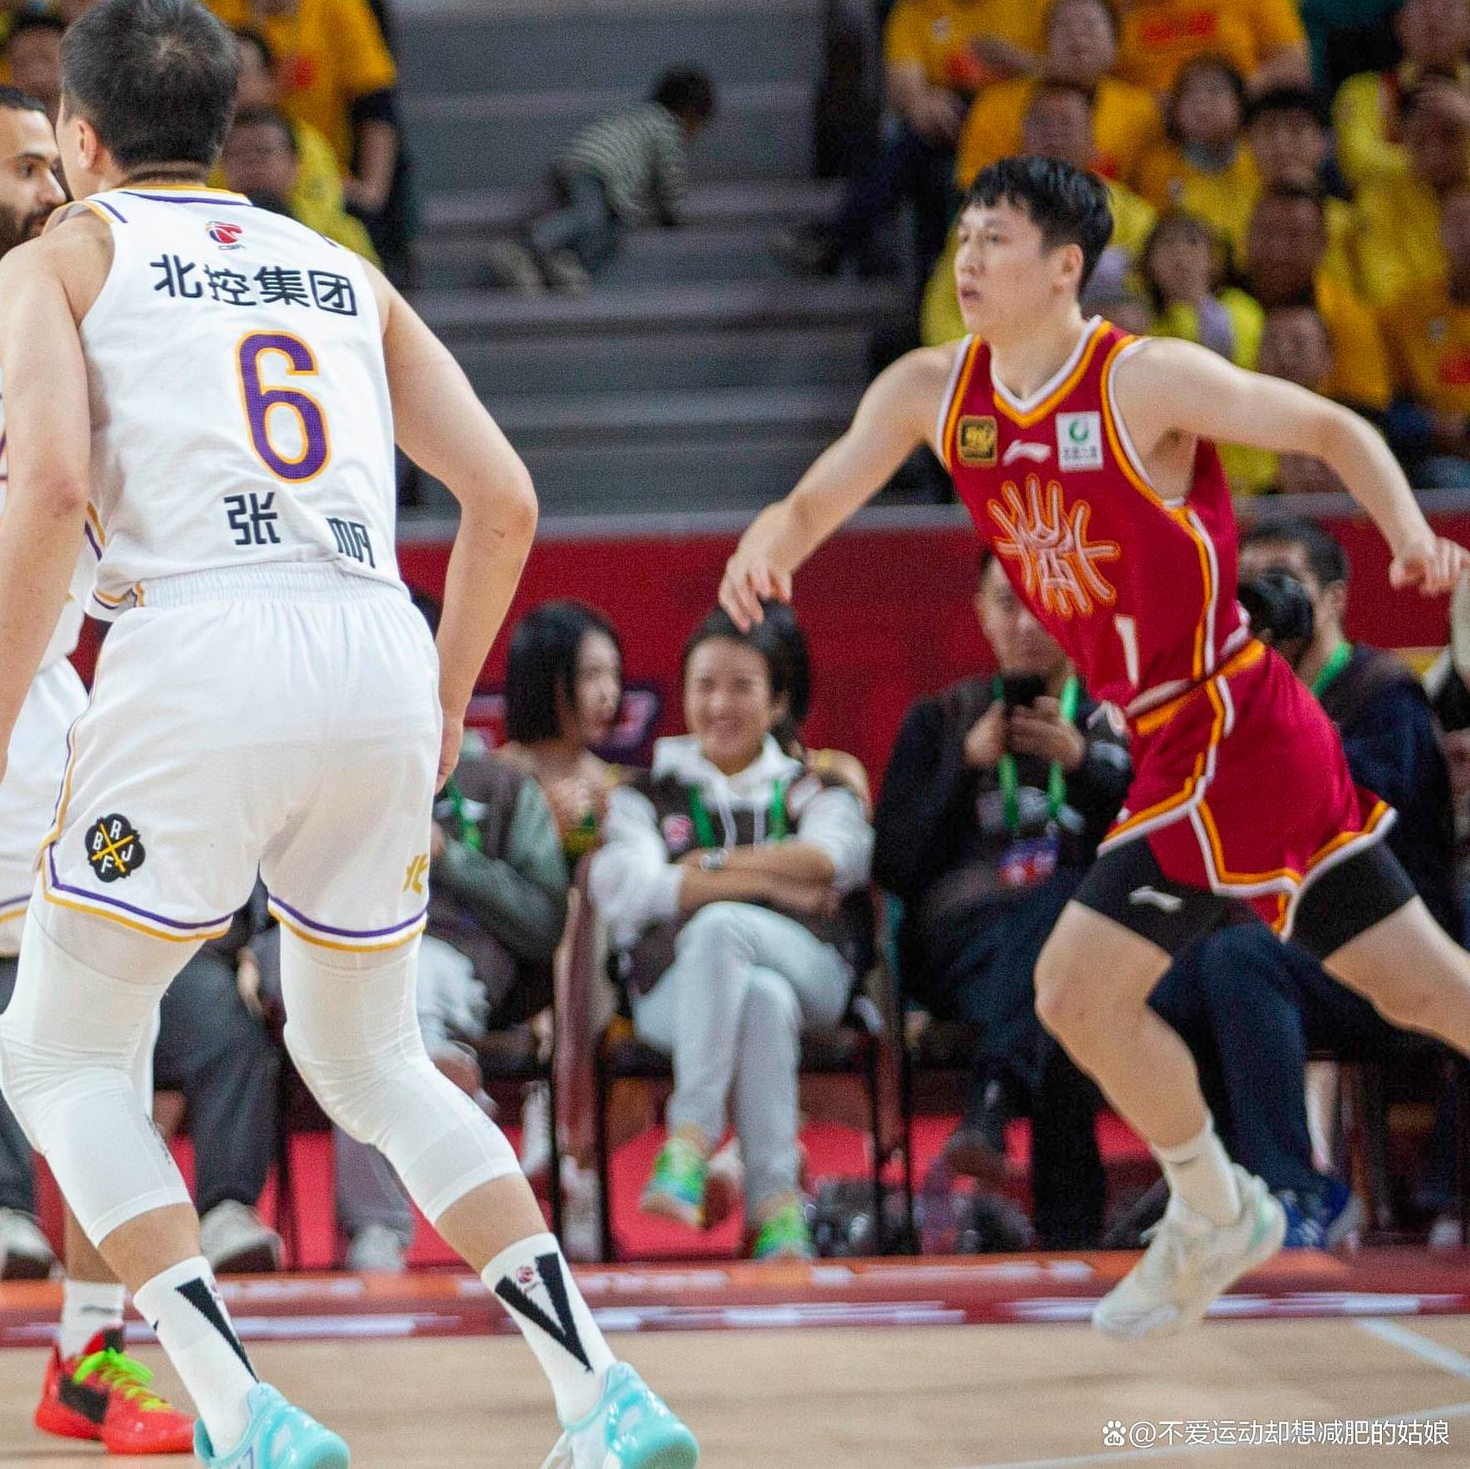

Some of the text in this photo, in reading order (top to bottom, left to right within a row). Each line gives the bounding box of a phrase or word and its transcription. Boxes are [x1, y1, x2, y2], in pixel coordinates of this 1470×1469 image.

[149, 253, 358, 316] 北控集团
[235, 330, 332, 483] 6
